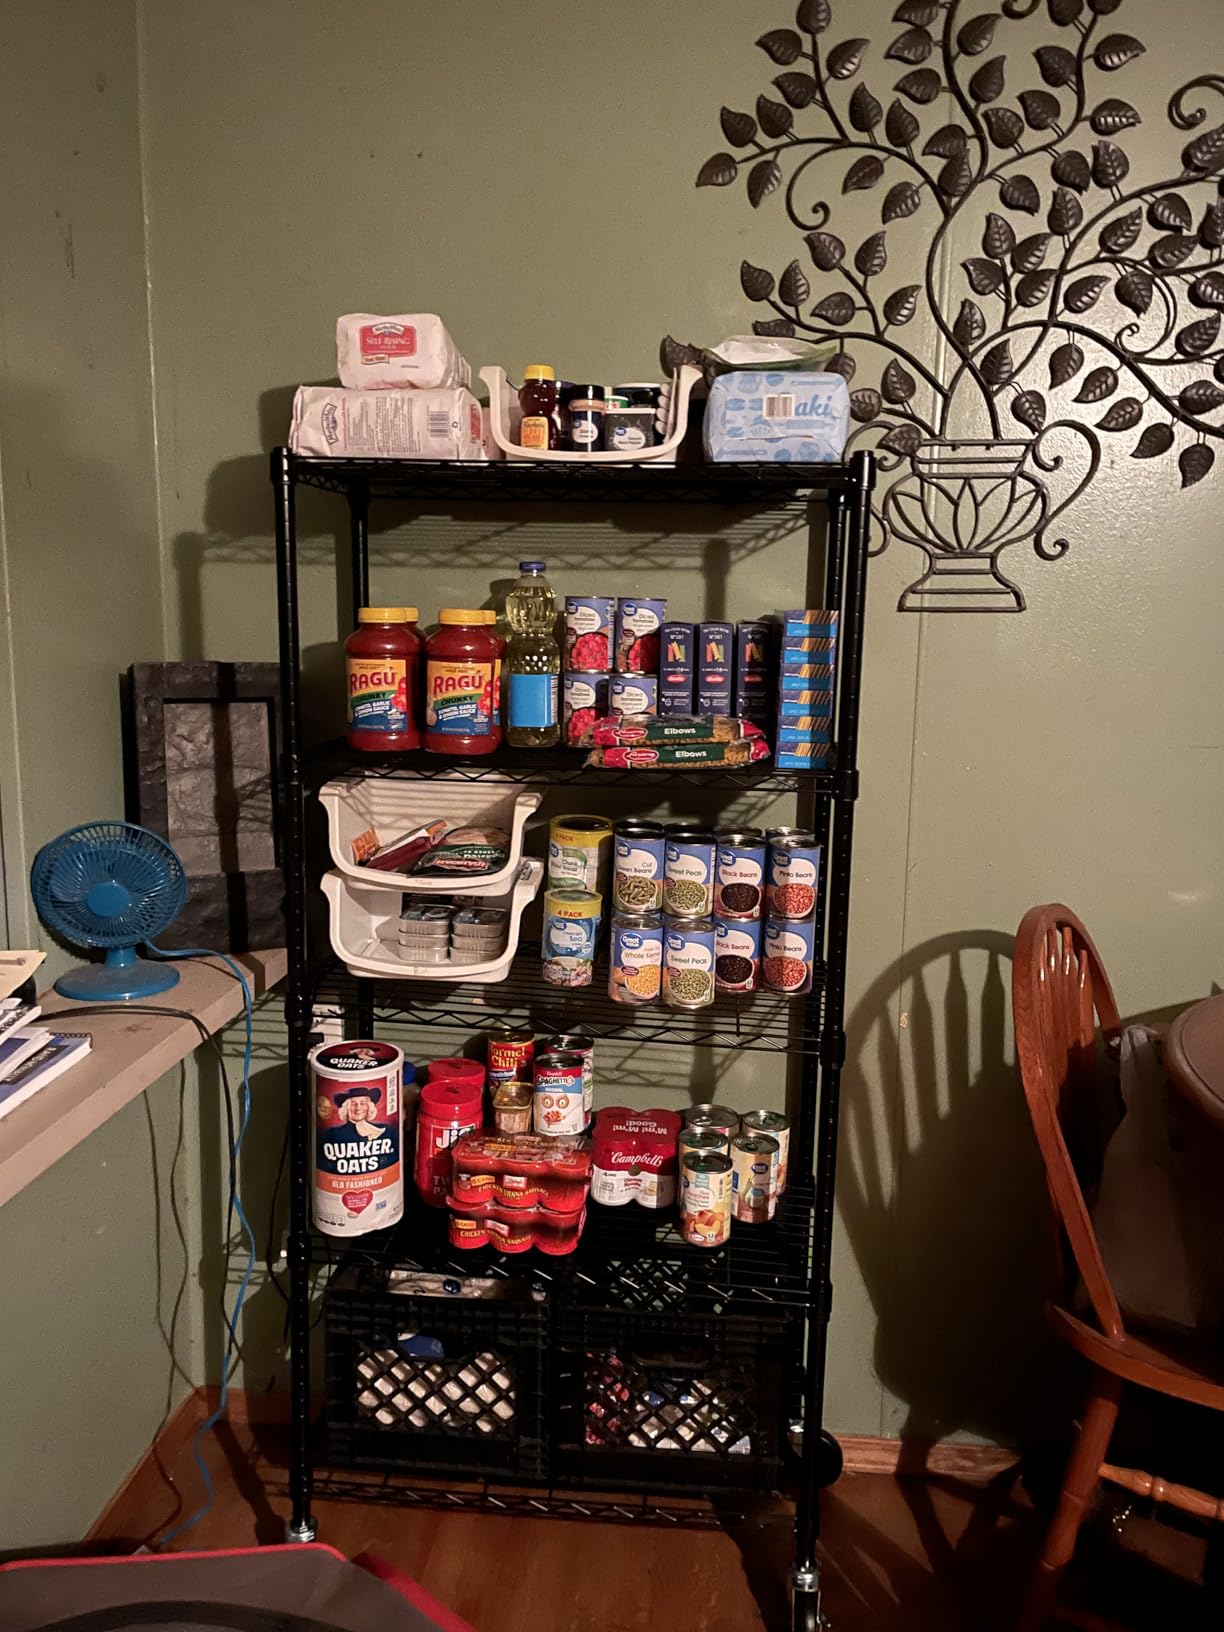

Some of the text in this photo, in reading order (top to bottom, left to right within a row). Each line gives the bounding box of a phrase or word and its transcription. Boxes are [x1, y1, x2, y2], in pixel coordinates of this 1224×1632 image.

[675, 750, 707, 758] Elbows
[716, 941, 730, 949] lack
[671, 954, 707, 965] Sweet Peas
[491, 1055, 518, 1068] Chili
[337, 1156, 379, 1174] OATS
[331, 1177, 383, 1189] OLD FASHIONED
